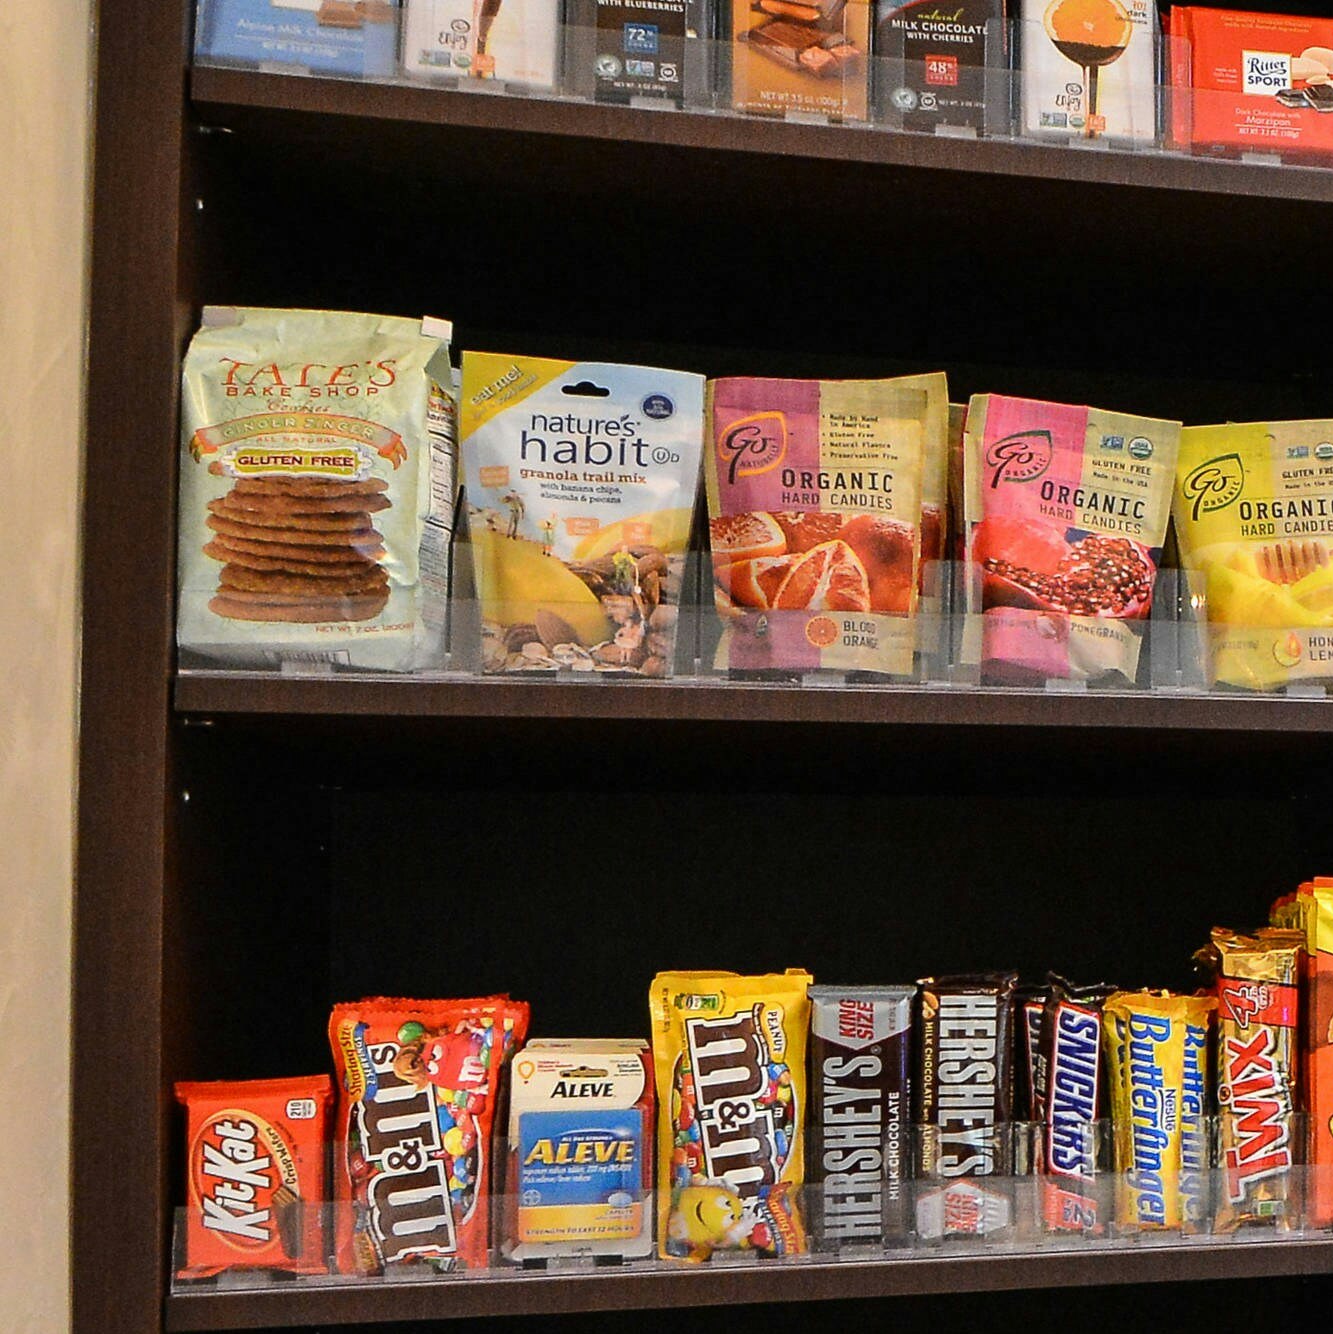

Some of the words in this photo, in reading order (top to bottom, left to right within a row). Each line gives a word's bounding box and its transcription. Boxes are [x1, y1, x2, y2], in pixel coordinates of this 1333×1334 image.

[892, 20, 918, 32] MILK
[922, 22, 988, 35] CHOCOLATE
[907, 32, 930, 40] WITH
[933, 33, 974, 43] CHERRIES
[1247, 75, 1287, 87] SPORT
[1246, 116, 1291, 127] Marzipan
[219, 357, 397, 388] TATE'S
[226, 387, 291, 398] BAKE
[311, 386, 380, 397] SHOP
[238, 455, 303, 467] GLUTEN
[310, 455, 355, 468] FREE
[520, 431, 650, 467] habit
[519, 467, 578, 482] granola
[582, 471, 614, 483] trail
[617, 472, 647, 484] mix
[1092, 459, 1126, 472] GLUTEN
[1129, 464, 1152, 476] FREE
[1282, 469, 1315, 479] GLUTEN
[781, 468, 893, 494] ORGANIC
[781, 493, 820, 505] HARD
[830, 494, 893, 511] CANDIES
[1040, 480, 1146, 519] ORGANIC
[1040, 504, 1073, 520] HARD
[1082, 512, 1142, 534] CANDIES
[1241, 522, 1275, 536] HARD
[857, 1001, 874, 1040] SIZE
[550, 1081, 615, 1099] ALEVE
[937, 995, 997, 1177] HERSHEY'S
[1052, 1011, 1099, 1178] SNICKERS
[889, 1092, 900, 1168] CHOCOLATE
[1129, 1012, 1171, 1226] Butterfinger
[524, 1138, 637, 1166] ALEVE
[823, 1056, 882, 1238] HERSHEY'S
[889, 1171, 900, 1199] MILK
